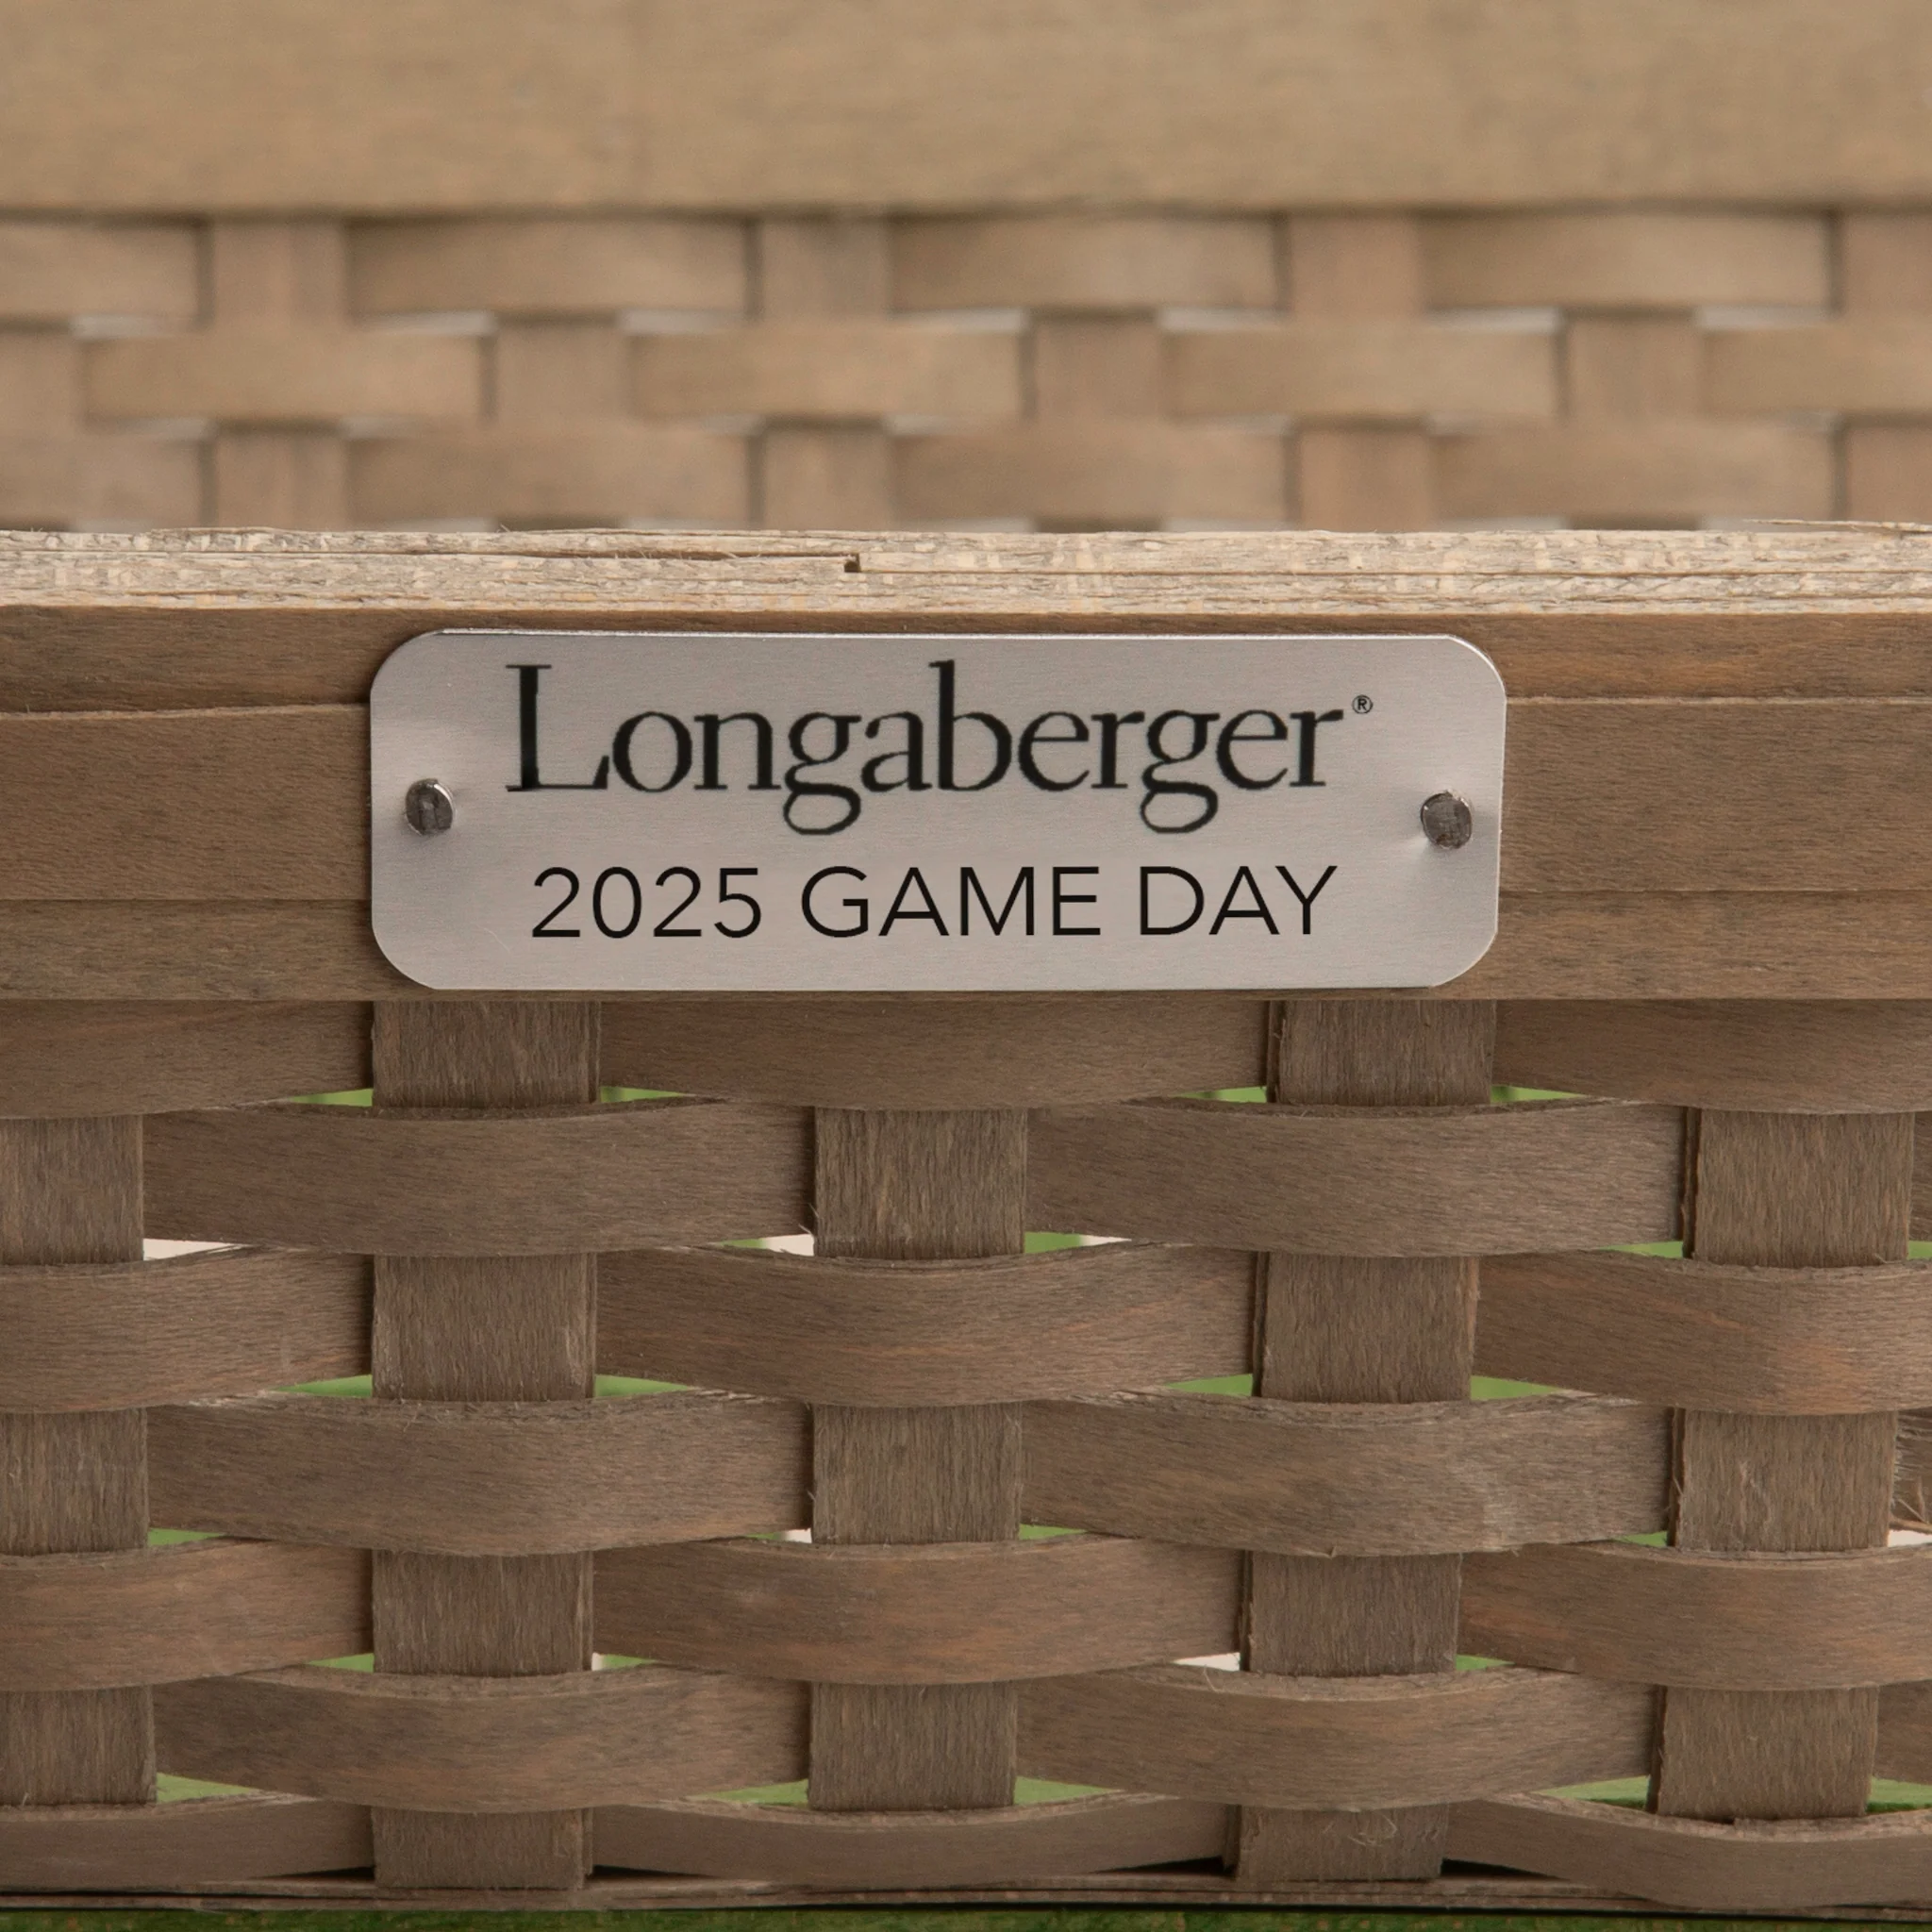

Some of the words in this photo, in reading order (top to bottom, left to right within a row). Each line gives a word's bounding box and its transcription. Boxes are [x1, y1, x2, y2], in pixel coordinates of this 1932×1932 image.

[531, 866, 762, 940] 2025
[801, 865, 1102, 939] GAME
[1139, 865, 1338, 936] DAY
